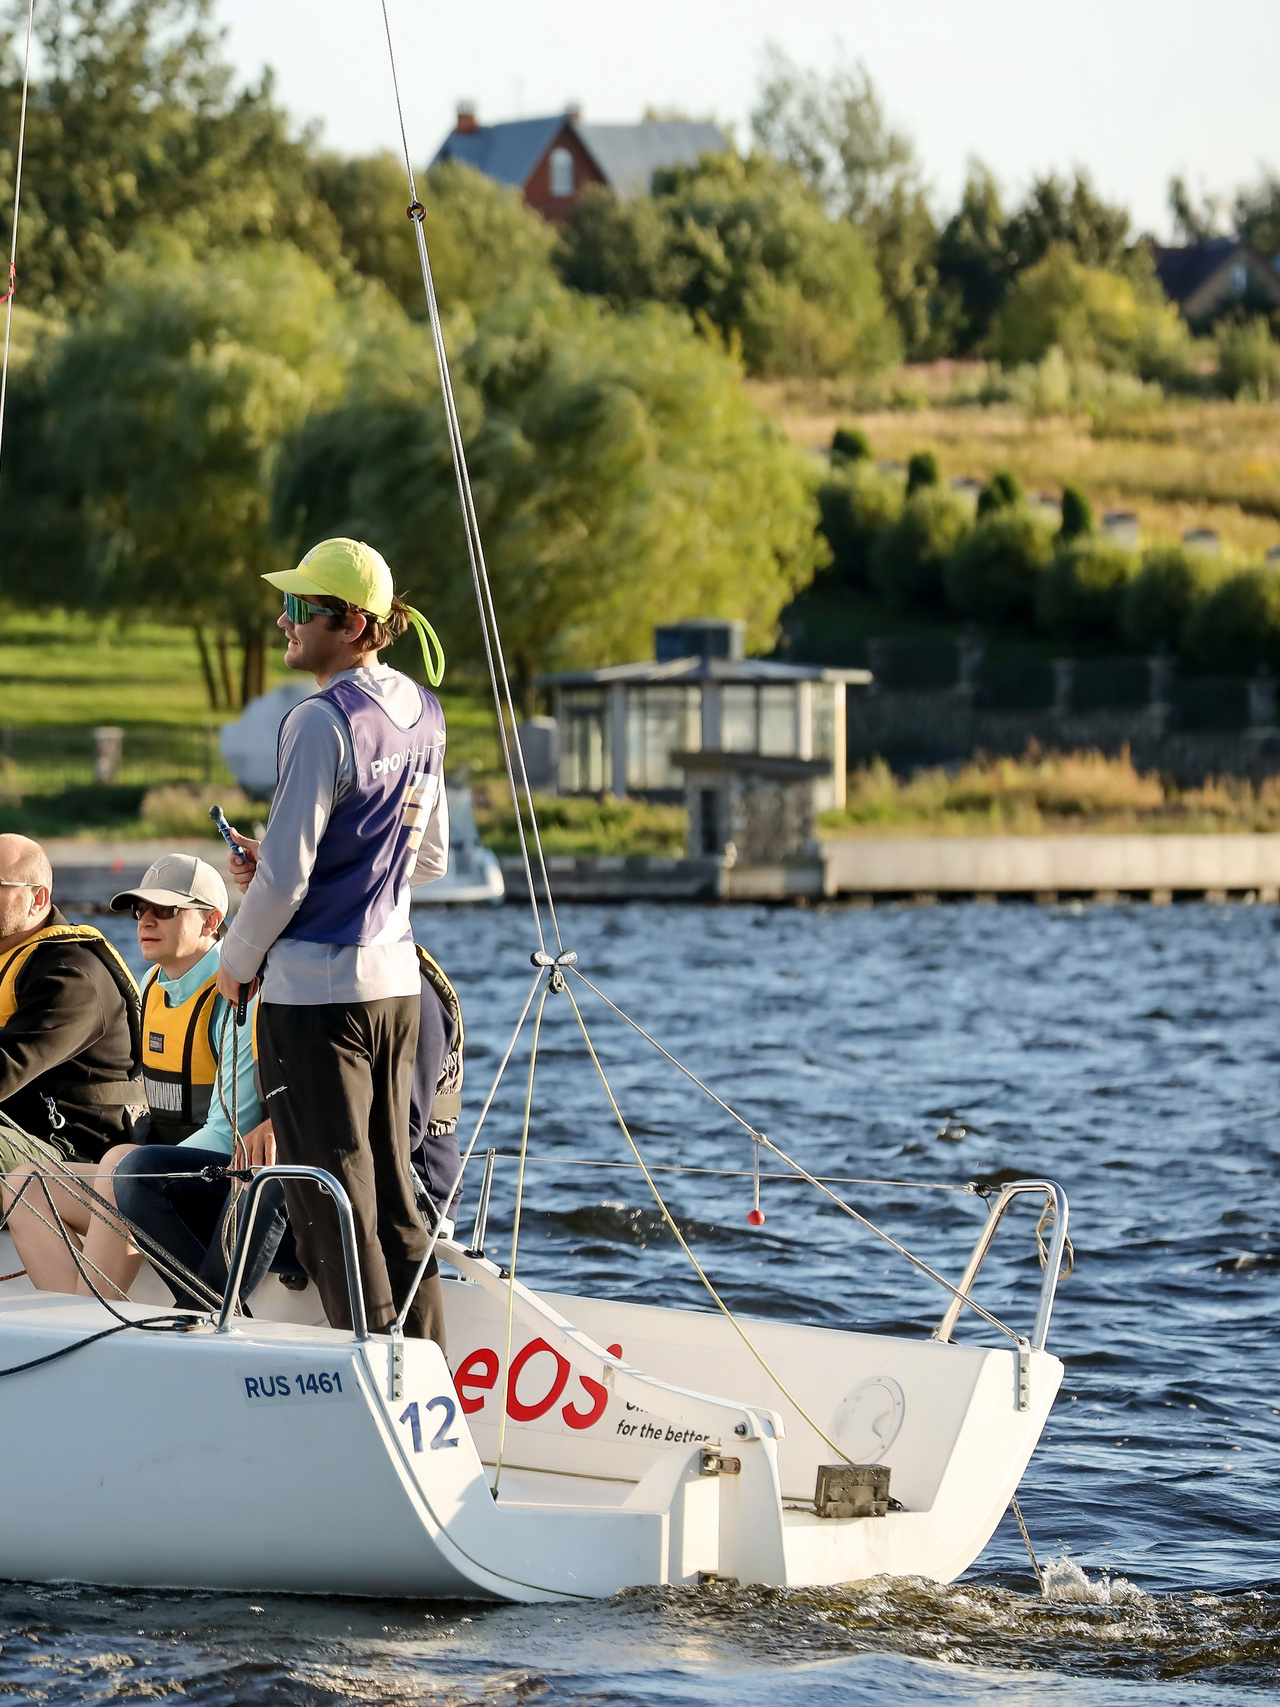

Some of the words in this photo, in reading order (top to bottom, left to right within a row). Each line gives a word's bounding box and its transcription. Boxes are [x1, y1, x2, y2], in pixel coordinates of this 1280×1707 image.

[245, 1374, 291, 1399] RUS
[295, 1371, 343, 1395] 1461
[398, 1395, 459, 1454] 12
[616, 1418, 638, 1436] for
[640, 1422, 663, 1439] the
[664, 1425, 710, 1443] better
